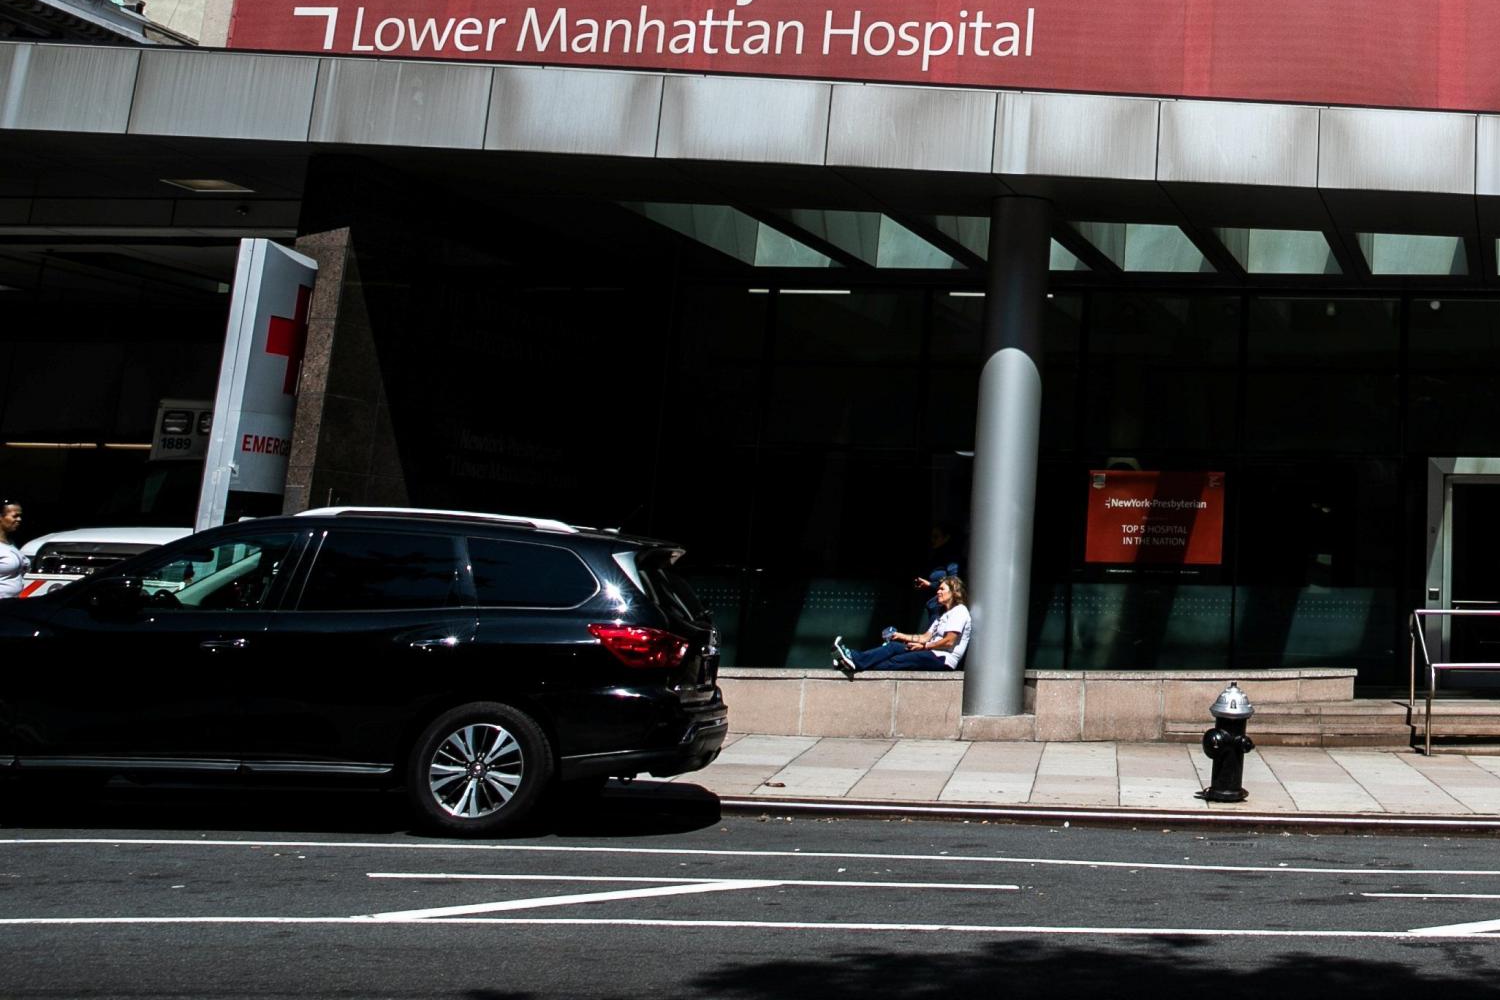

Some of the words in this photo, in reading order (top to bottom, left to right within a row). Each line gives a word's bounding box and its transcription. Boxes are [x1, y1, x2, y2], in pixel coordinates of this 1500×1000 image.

[352, 6, 505, 52] Lower
[516, 8, 806, 56] Manhattan
[821, 8, 1036, 71] Hospital
[161, 437, 191, 450] 1889
[1111, 498, 1207, 509] NewYork-Presbyterian
[1121, 525, 1138, 533] TOP
[1147, 525, 1188, 534] HOSPITAL
[1123, 537, 1133, 545] IN
[1134, 537, 1150, 545] THE
[1152, 537, 1185, 546] NATION
